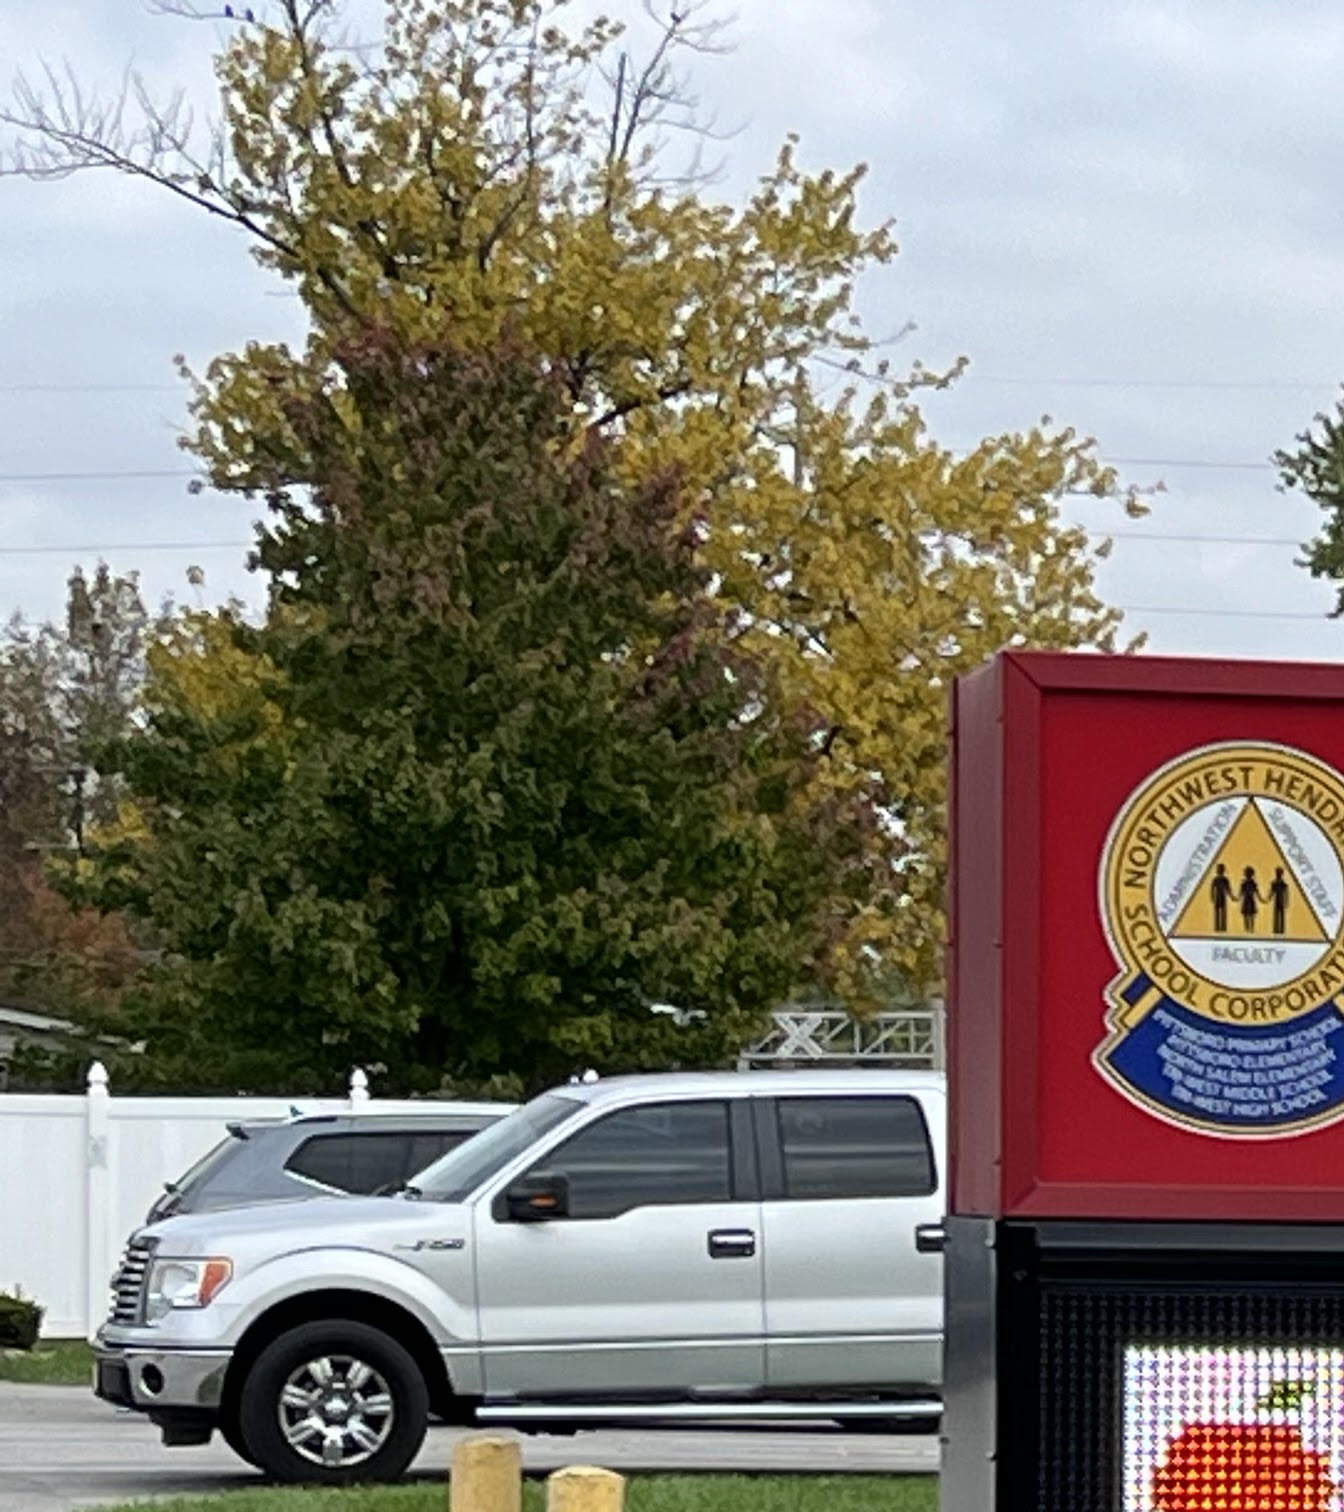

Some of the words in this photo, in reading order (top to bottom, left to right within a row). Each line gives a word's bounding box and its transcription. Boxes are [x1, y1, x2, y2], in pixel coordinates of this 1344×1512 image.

[1124, 766, 1256, 890] NORTHWEST
[1158, 803, 1237, 922] ADMINISTRATION
[1268, 807, 1314, 875] SUPPORT
[1305, 874, 1338, 918] STAFF
[1123, 903, 1199, 1007] SCHOOL
[1211, 947, 1286, 964] FACULTY
